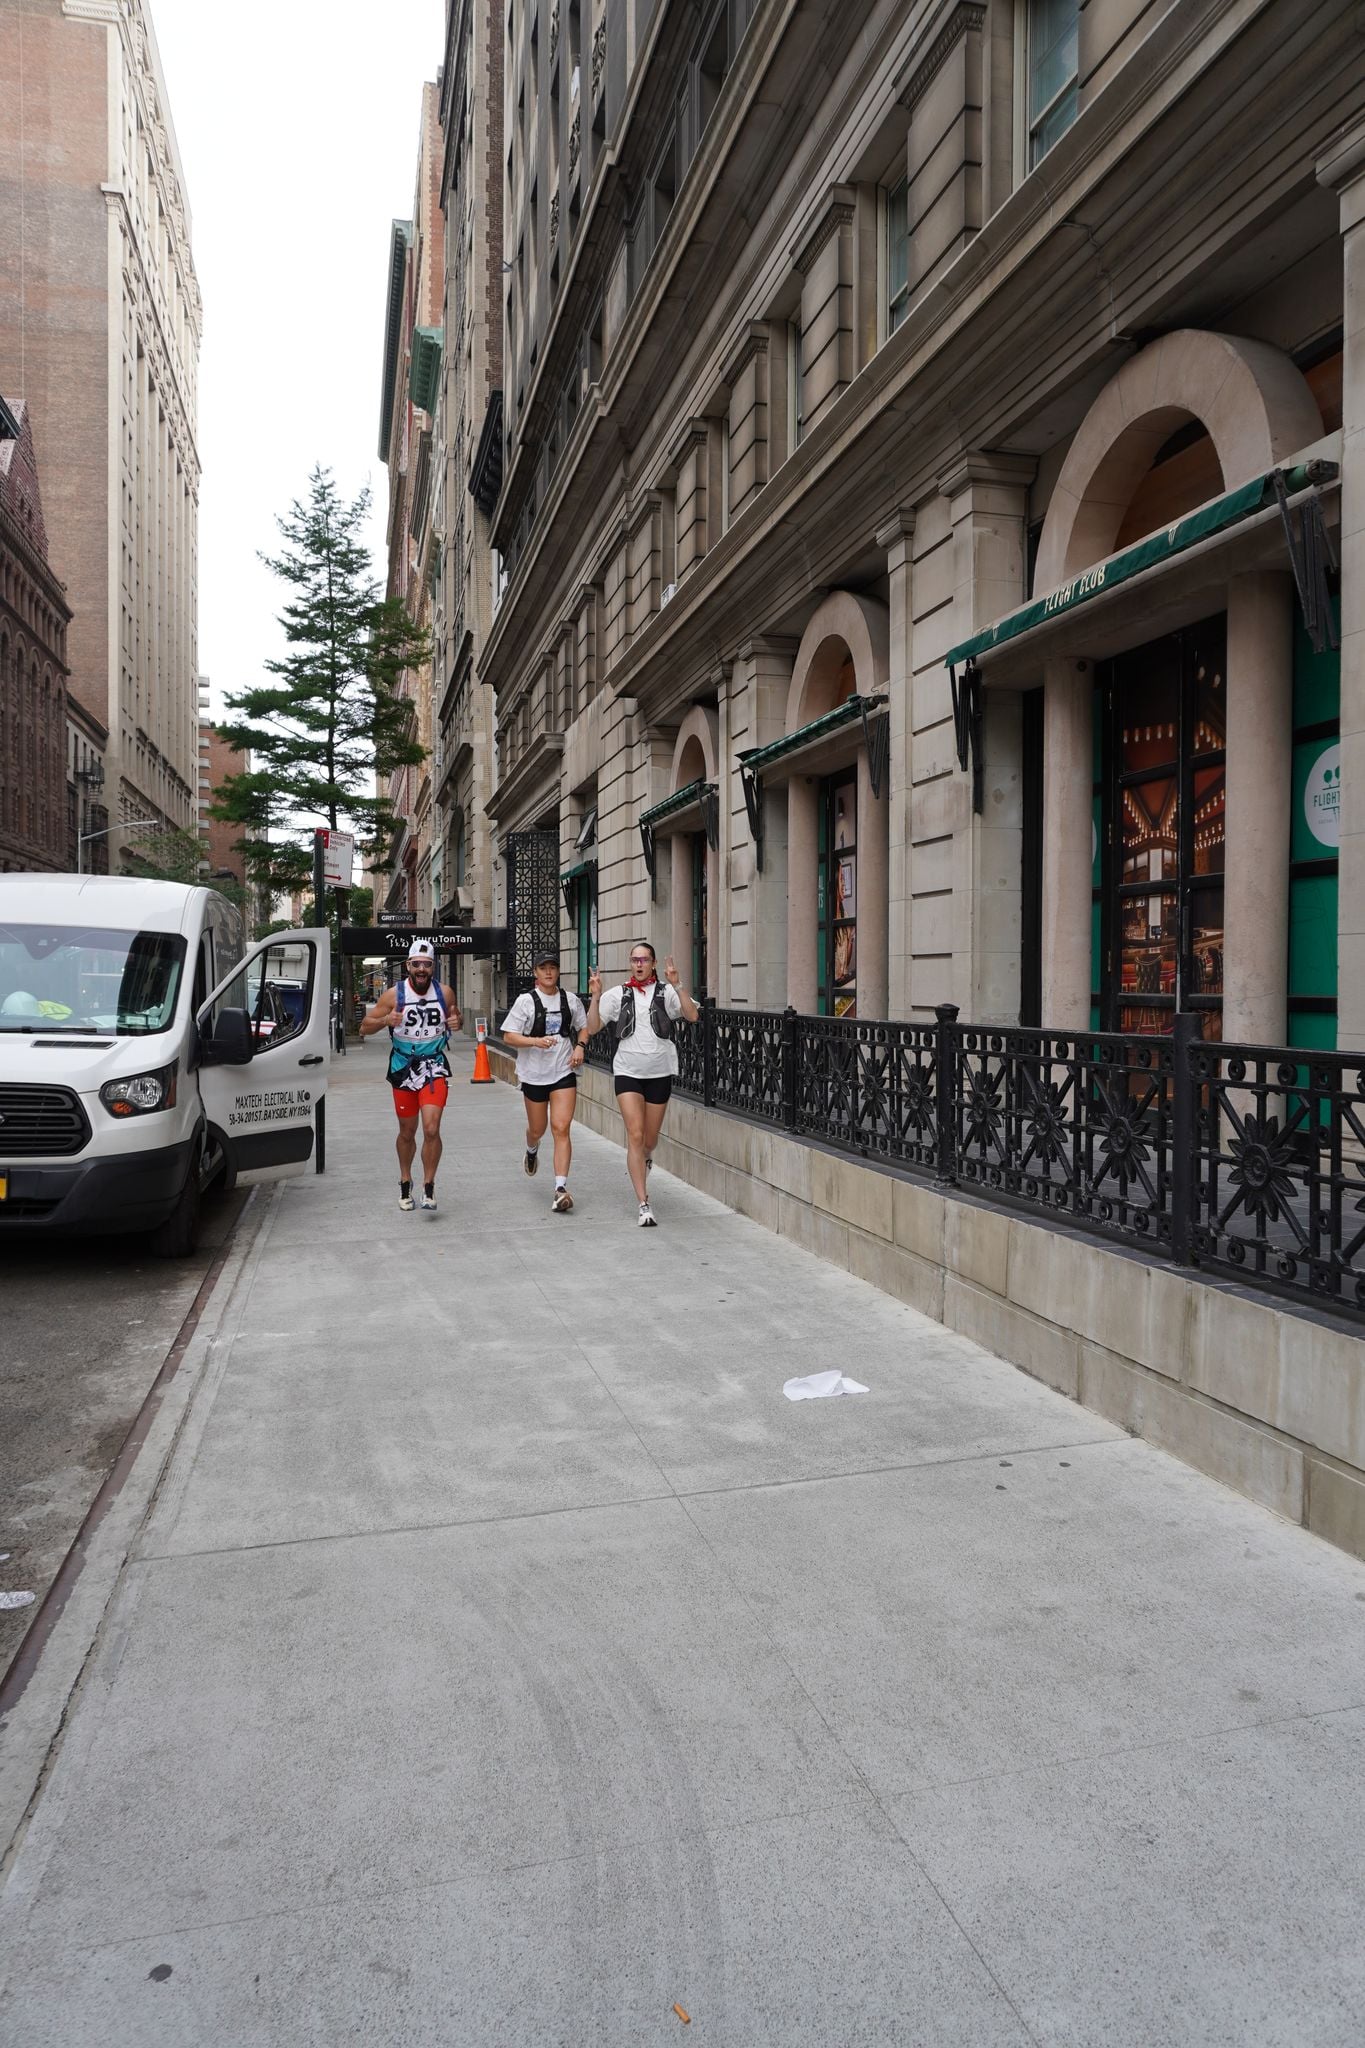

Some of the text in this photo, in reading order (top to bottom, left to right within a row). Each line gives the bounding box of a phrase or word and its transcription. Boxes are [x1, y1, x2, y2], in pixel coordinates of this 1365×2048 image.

[1044, 566, 1106, 614] FLIGHT CLUB
[405, 1007, 441, 1028] SYB
[235, 1095, 262, 1109] MAXTECH
[264, 1092, 294, 1106] ELECTRICAL
[289, 1105, 298, 1118] NY
